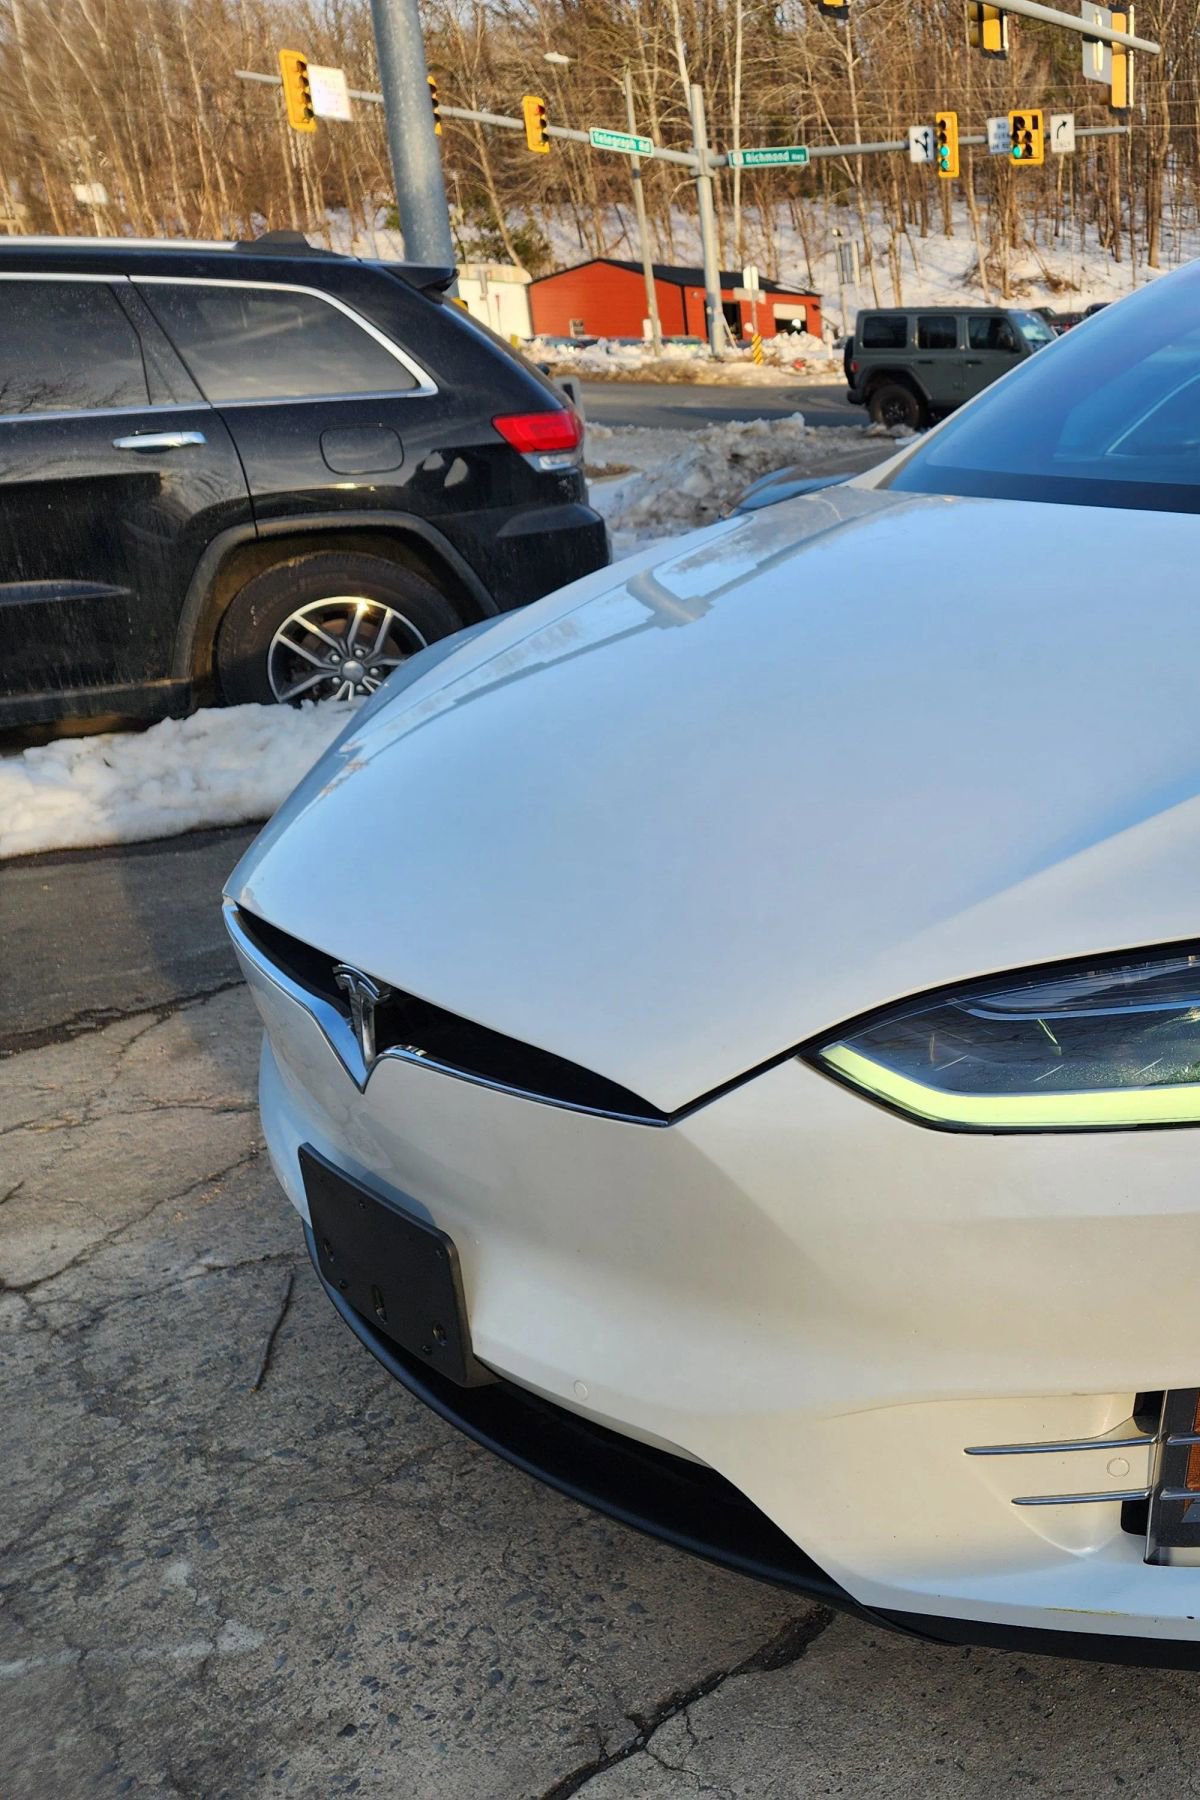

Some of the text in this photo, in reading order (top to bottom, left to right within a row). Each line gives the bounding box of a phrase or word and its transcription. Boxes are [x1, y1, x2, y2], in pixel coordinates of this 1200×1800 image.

[594, 131, 651, 152] Telegraph Rd
[745, 151, 790, 163] Richmond
